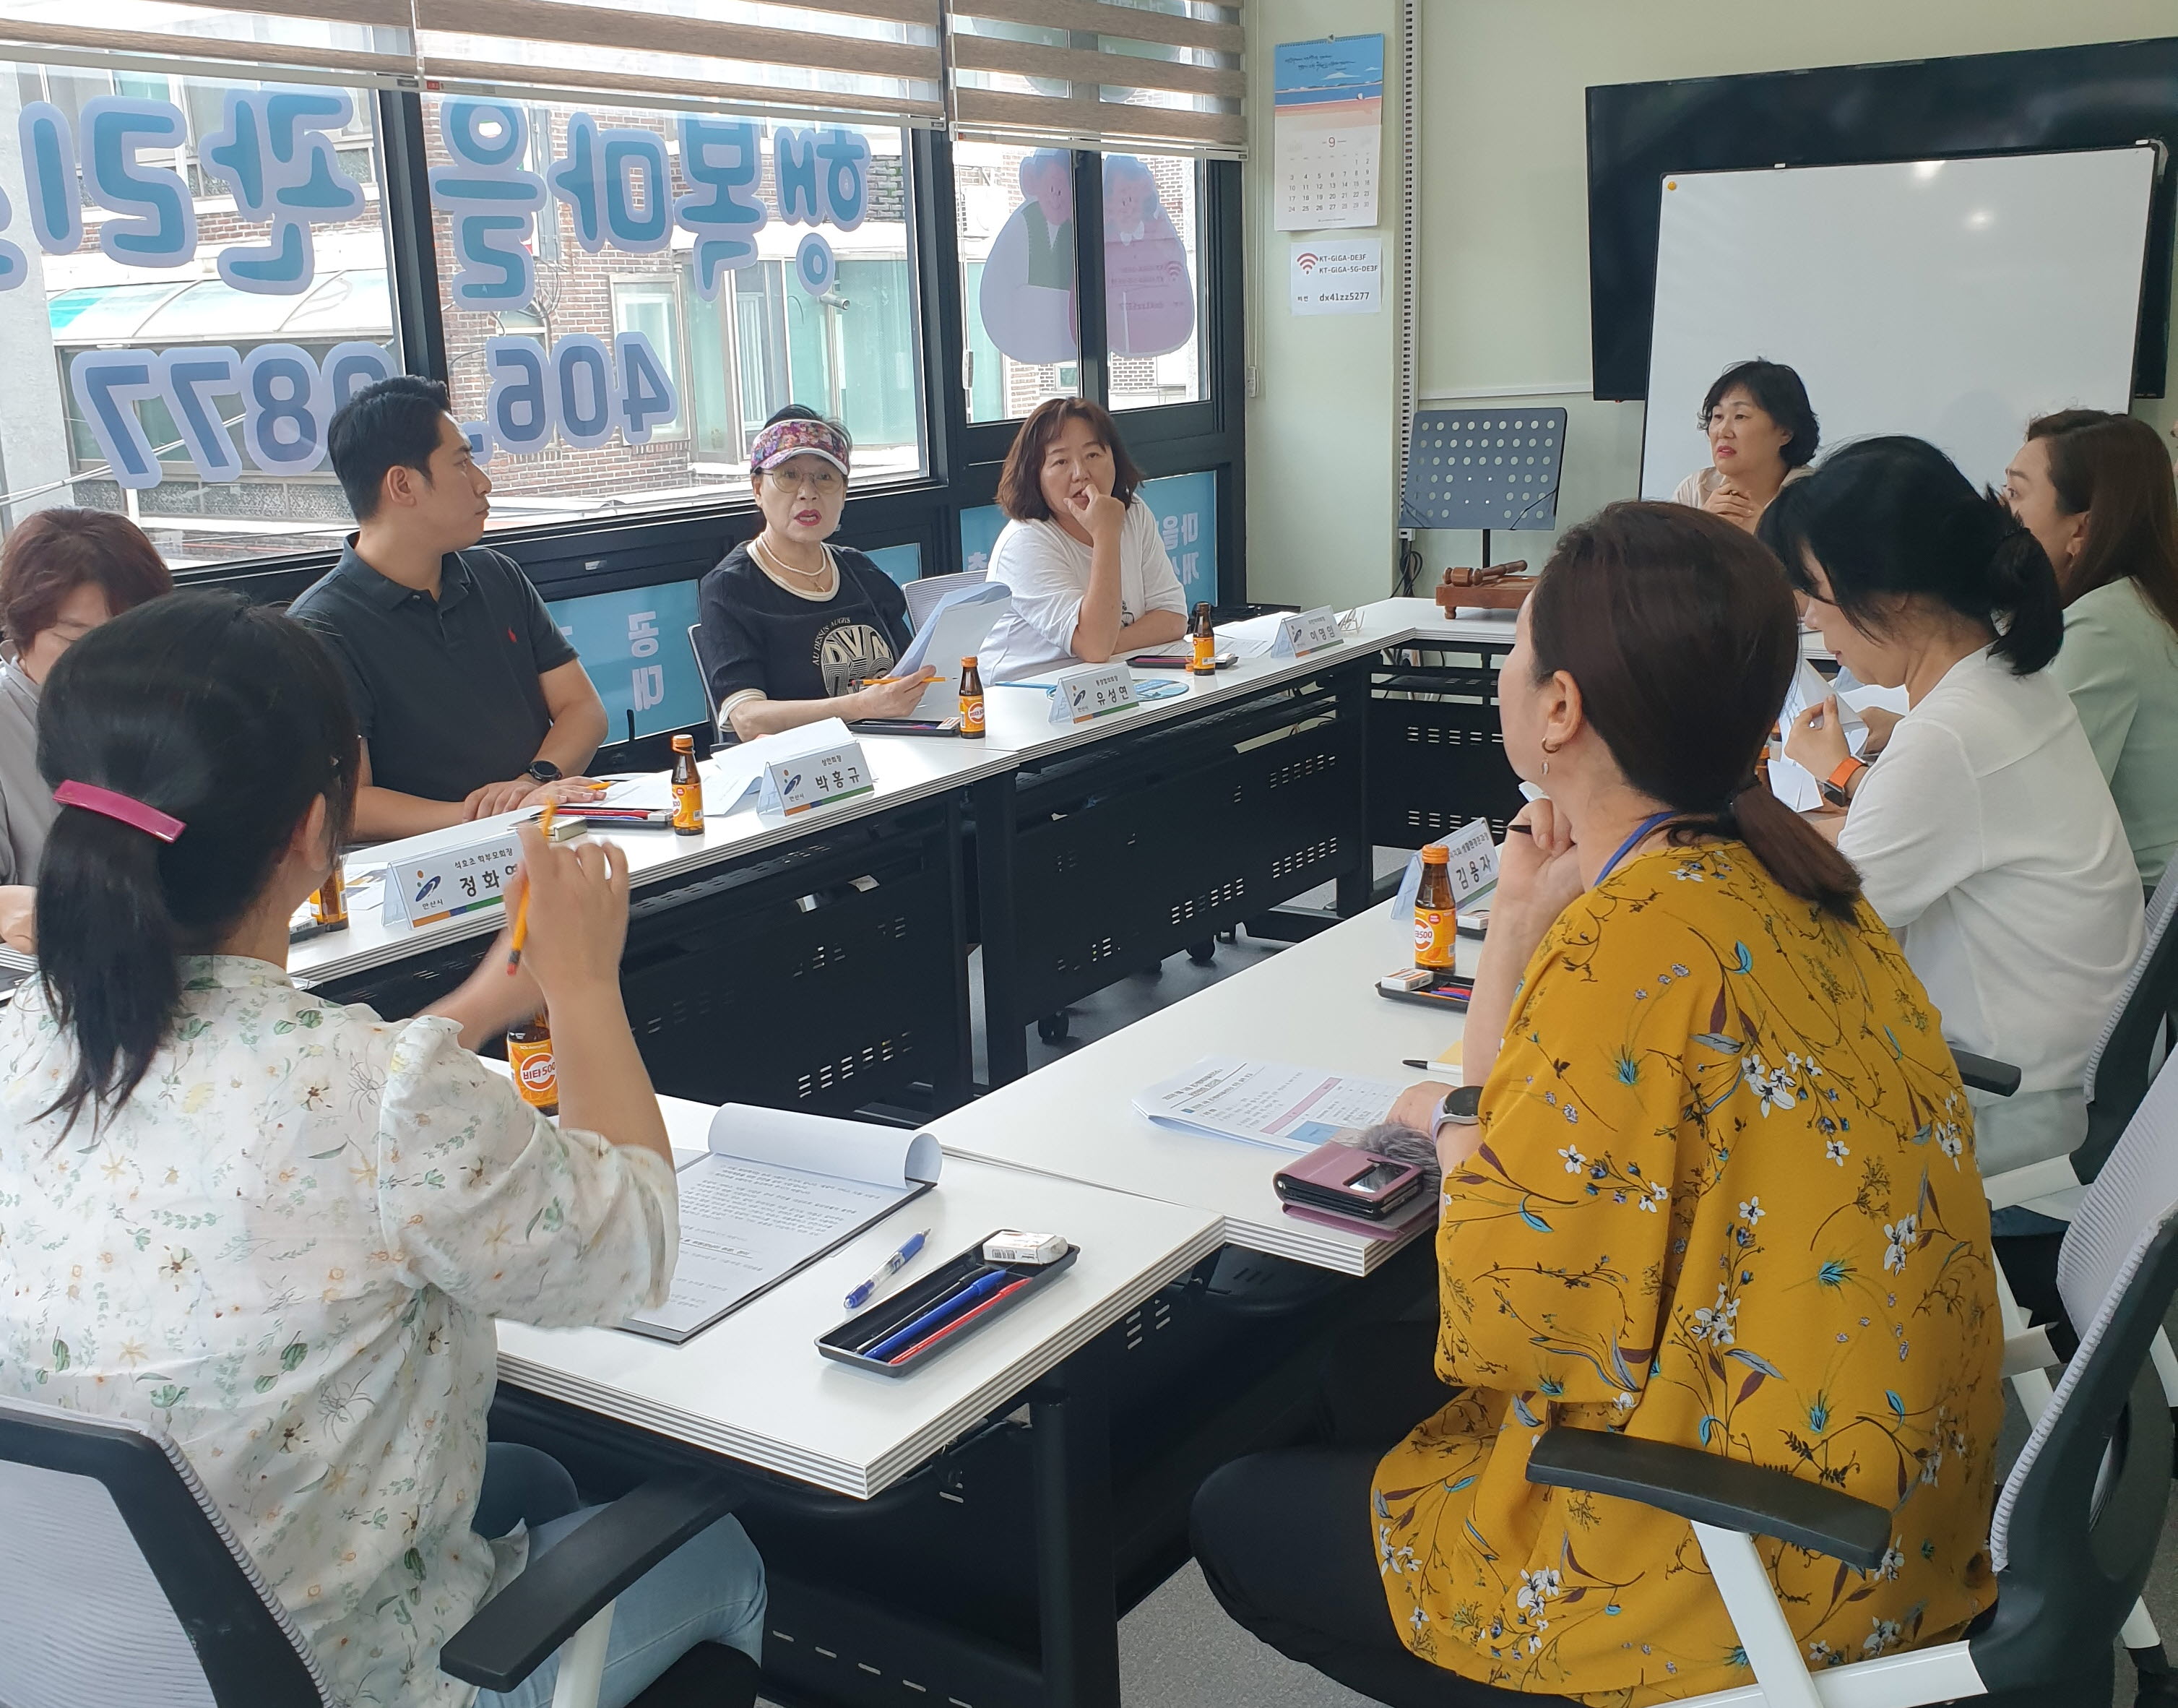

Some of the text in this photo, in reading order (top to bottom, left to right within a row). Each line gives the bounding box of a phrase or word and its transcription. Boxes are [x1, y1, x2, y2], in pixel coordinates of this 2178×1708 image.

[1328, 137, 1335, 147] 9
[1319, 254, 1367, 262] KT-GIGA-DE3F
[1319, 265, 1378, 274] KT-GIGA-5G-DE3F
[1097, 686, 1129, 706] 유성연
[816, 767, 860, 792] 박홍규
[1456, 854, 1492, 890] 김용자
